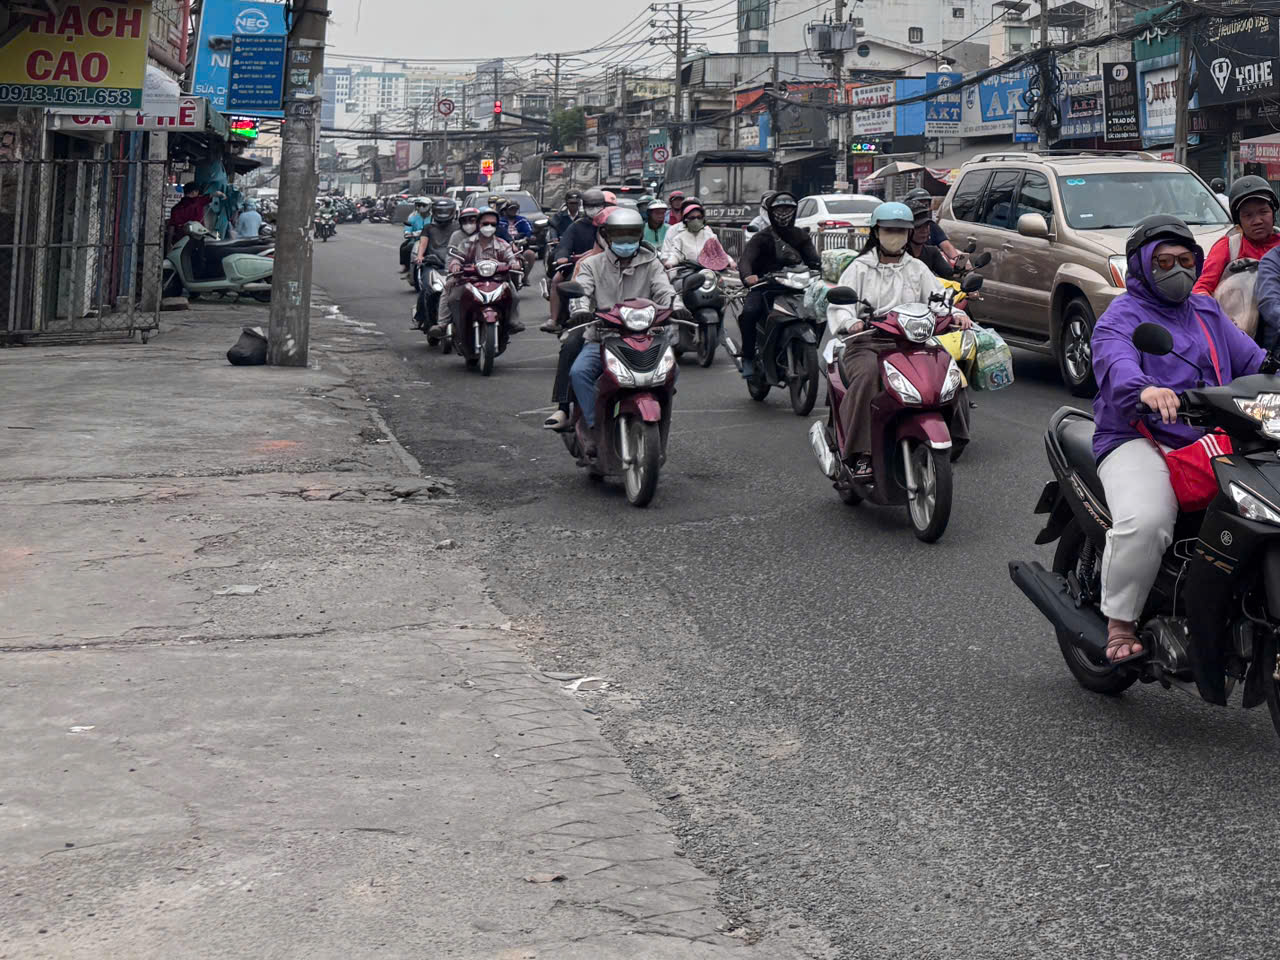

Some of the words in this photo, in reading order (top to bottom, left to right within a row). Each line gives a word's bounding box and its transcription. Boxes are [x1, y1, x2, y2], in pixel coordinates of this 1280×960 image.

[30, 5, 143, 43] HẠCH
[234, 17, 270, 29] NEO
[26, 49, 110, 83] CAO
[1235, 60, 1273, 86] YOHE
[0, 84, 131, 105] 0913.161.658
[212, 97, 225, 106] XE
